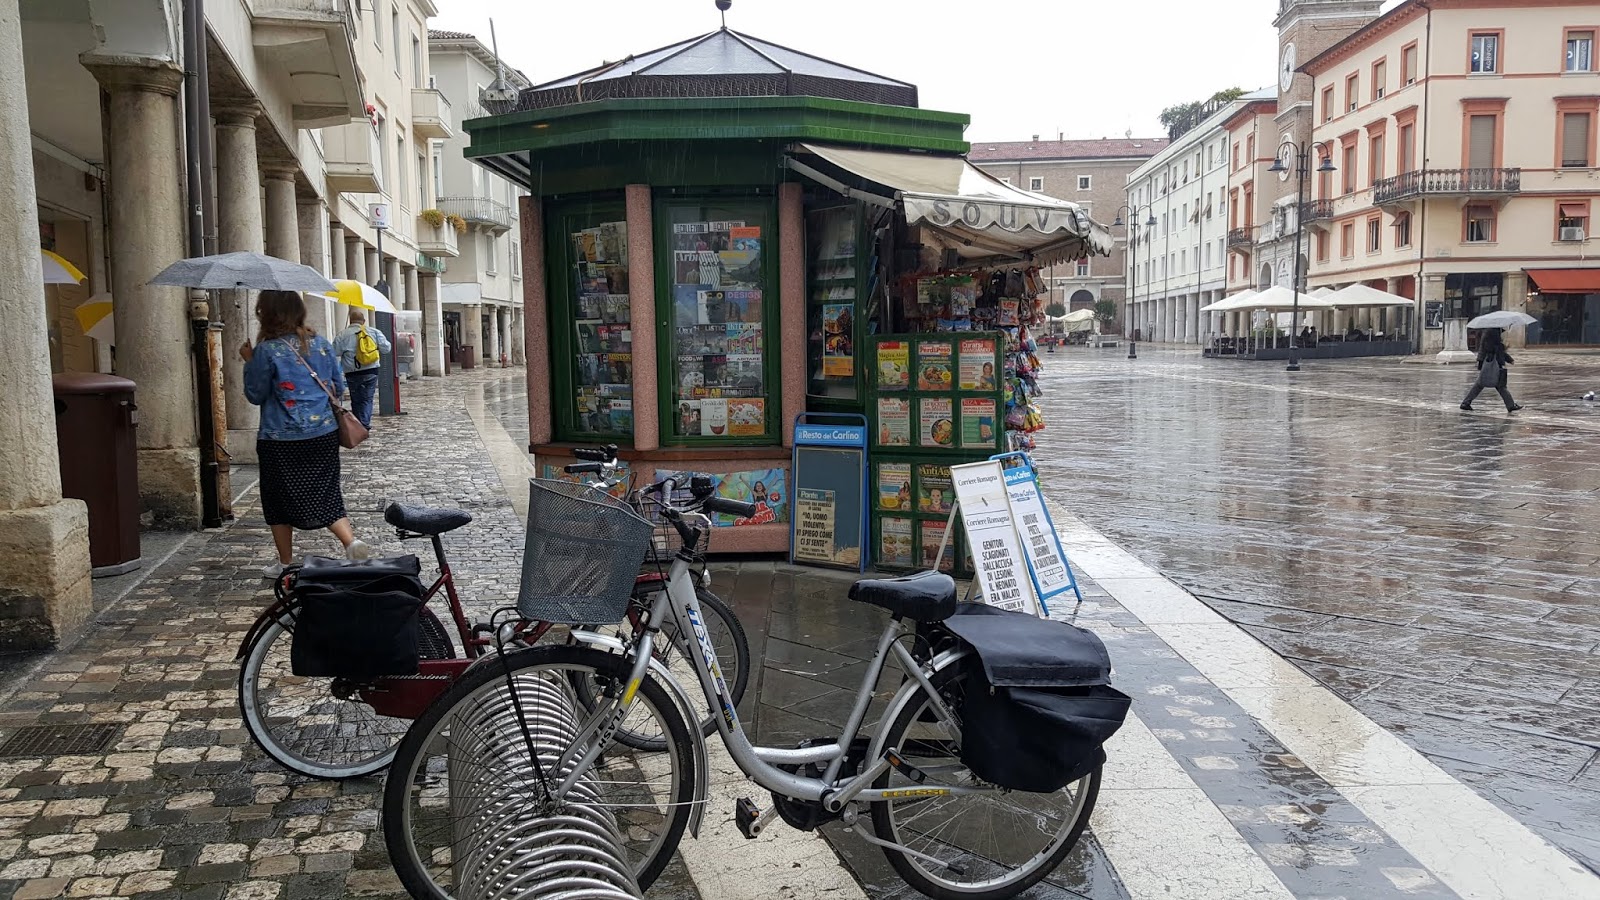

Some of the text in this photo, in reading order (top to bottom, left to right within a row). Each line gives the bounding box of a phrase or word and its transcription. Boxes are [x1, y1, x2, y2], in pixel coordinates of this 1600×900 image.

[728, 291, 760, 299] DESIGN
[803, 430, 822, 439] Resto
[832, 430, 860, 440] Carlino
[920, 466, 952, 478] AntiAg
[957, 477, 977, 487] Corriere
[976, 475, 998, 485] Romagna
[812, 512, 828, 521] UOMO
[966, 515, 1010, 527] Corriere Romagna
[801, 529, 819, 538] SPIEGO
[819, 530, 833, 539] COME
[982, 538, 1005, 551] GENITORI
[981, 548, 1010, 561] SCAGIONATI
[982, 558, 1014, 572] DALL'ACCUSA
[986, 571, 994, 582] DI
[988, 578, 1018, 592] IL NEONATO
[990, 588, 1021, 603] ERA MALATO
[940, 700, 961, 730] cannonda
[599, 708, 625, 749] FLASH
